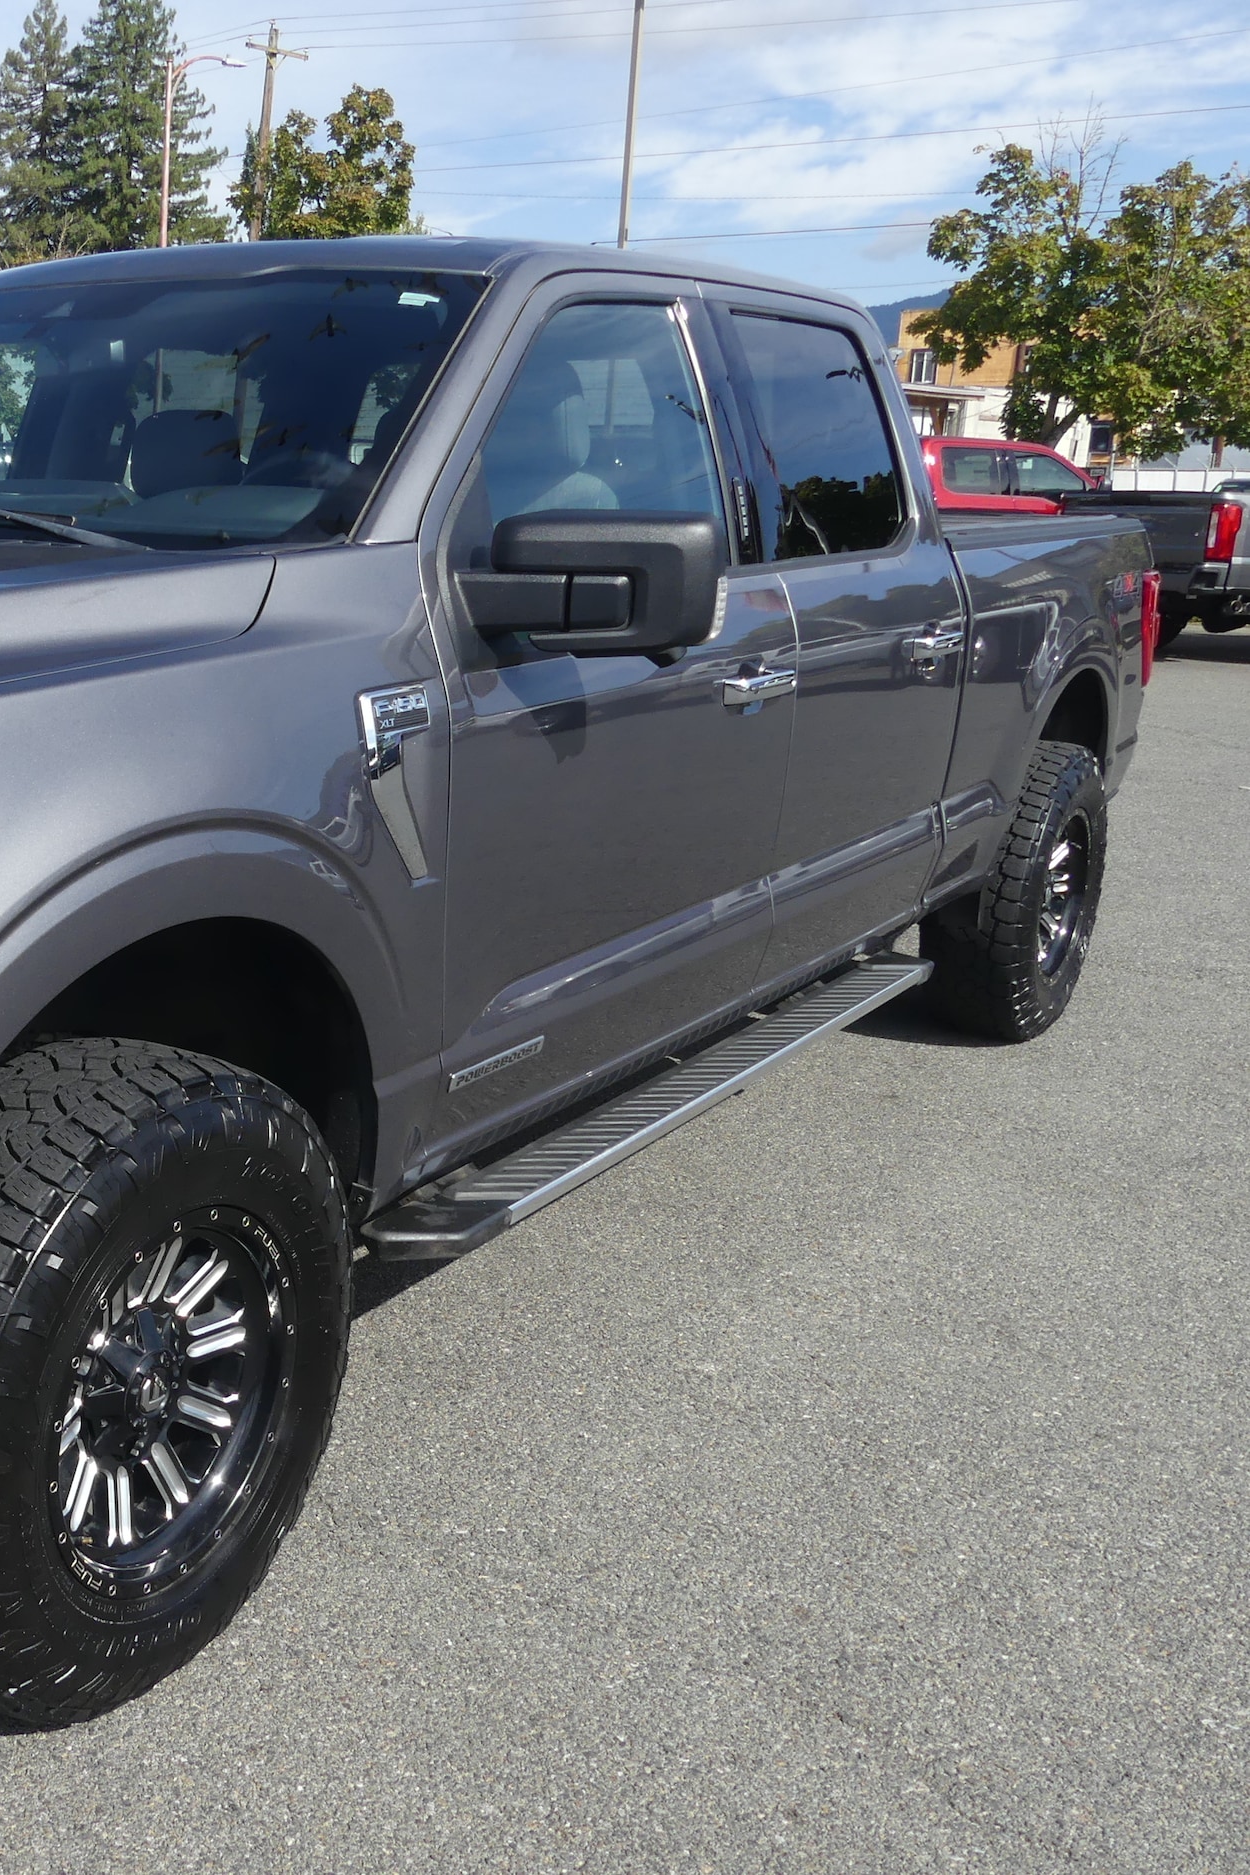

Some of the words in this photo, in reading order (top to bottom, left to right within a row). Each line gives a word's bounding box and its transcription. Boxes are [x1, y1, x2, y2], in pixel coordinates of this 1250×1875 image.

[379, 718, 395, 729] XLT
[455, 1041, 541, 1087] POWERBOOST
[253, 1225, 282, 1271] FUEL
[70, 1549, 103, 1591] FUEL
